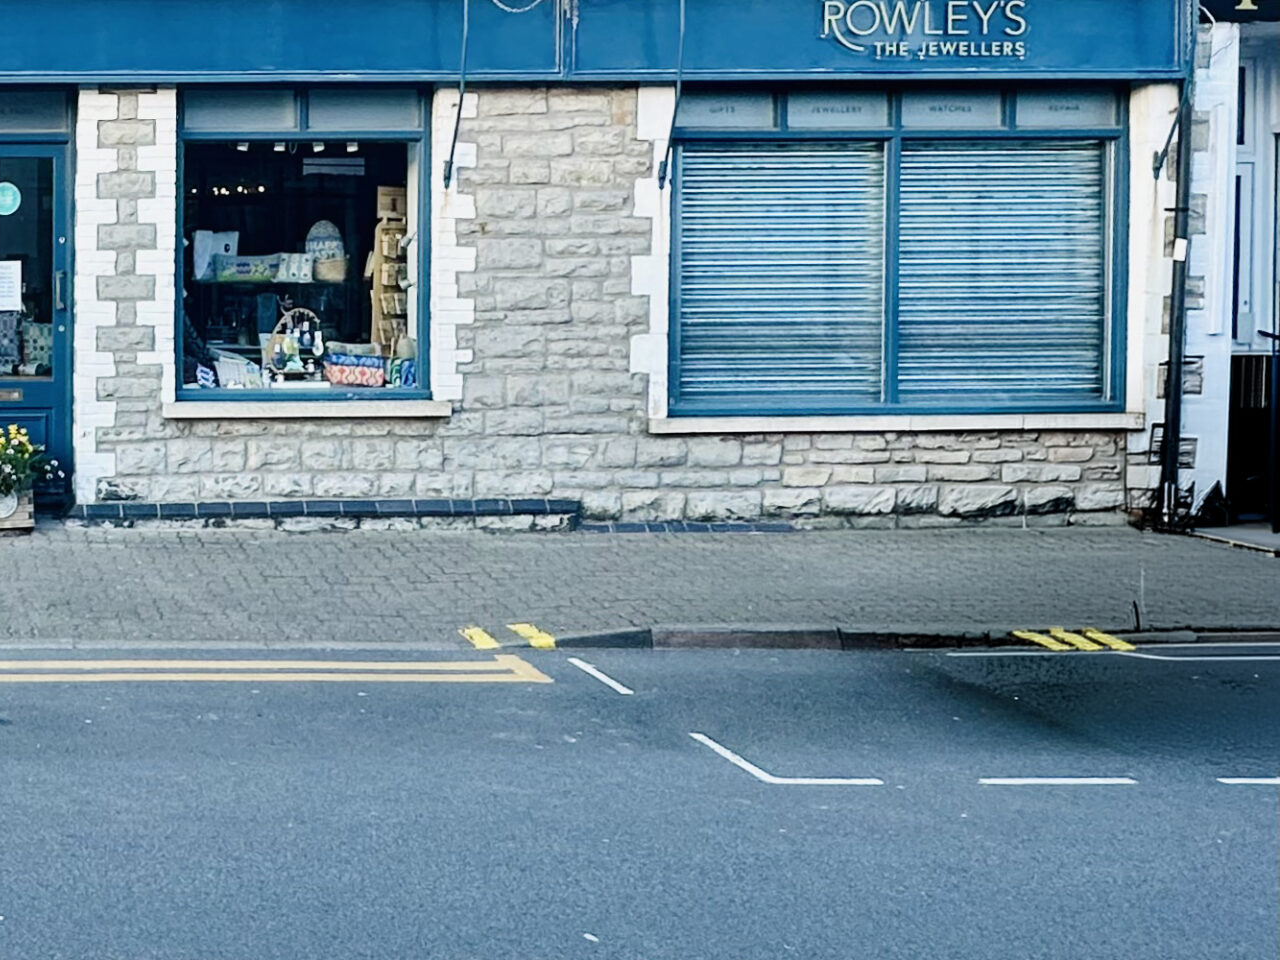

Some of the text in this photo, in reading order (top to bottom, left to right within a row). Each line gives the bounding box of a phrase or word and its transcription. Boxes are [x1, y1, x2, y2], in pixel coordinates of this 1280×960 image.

[823, 0, 1027, 51] ROWLEY'S
[875, 41, 1026, 56] THE JEWELLERS
[811, 106, 863, 114] JEWELLERY
[928, 105, 972, 113] WATCHES
